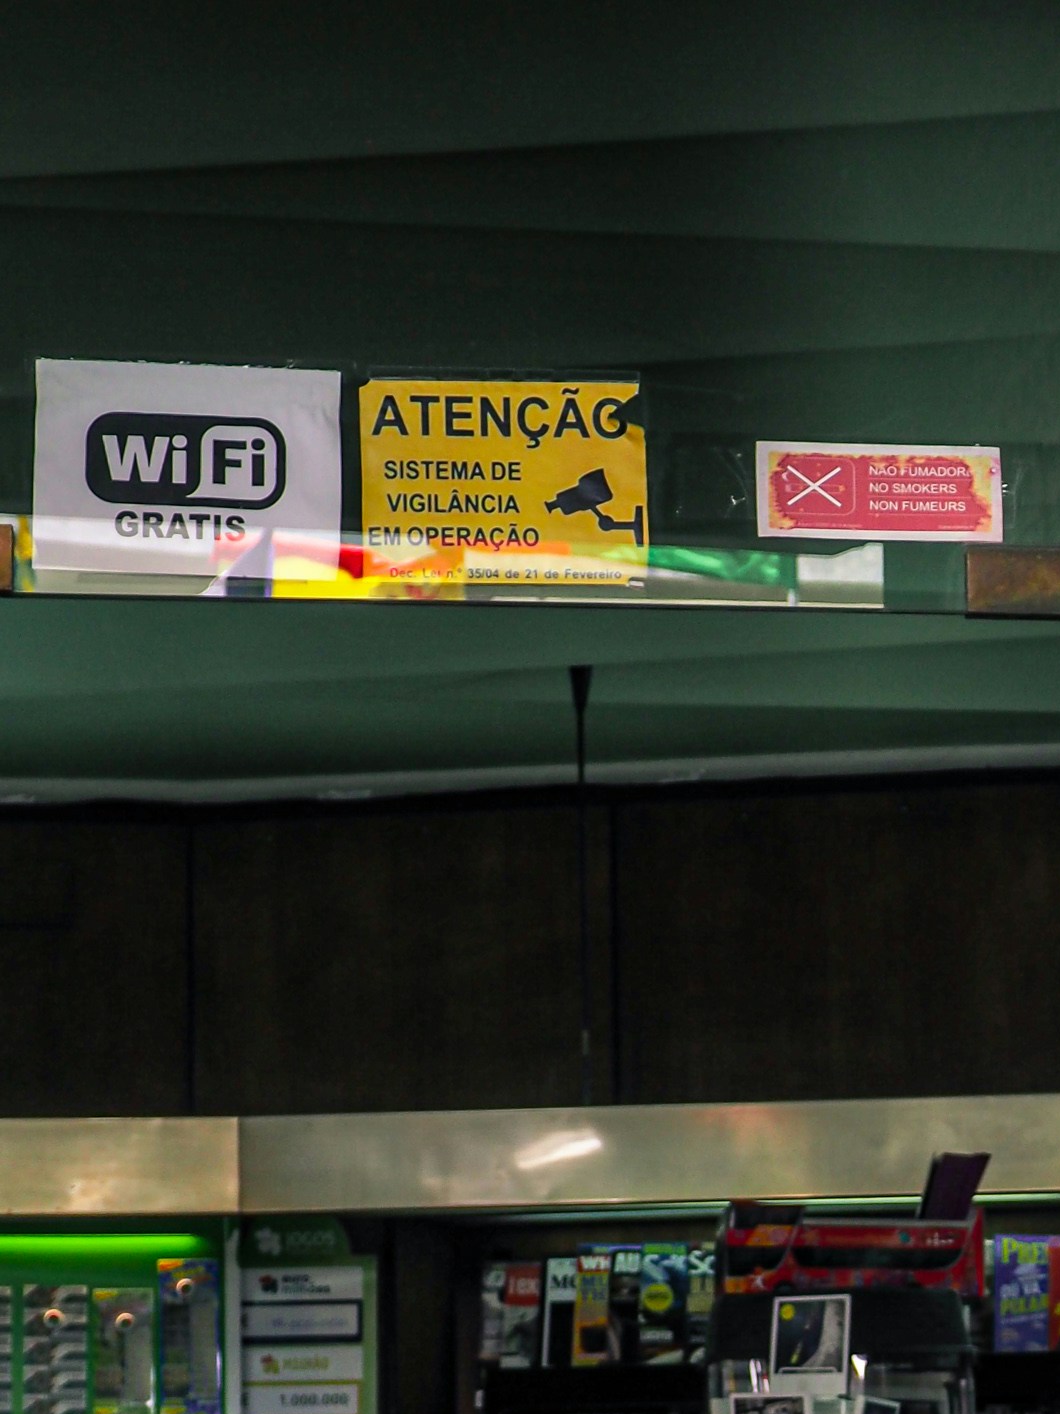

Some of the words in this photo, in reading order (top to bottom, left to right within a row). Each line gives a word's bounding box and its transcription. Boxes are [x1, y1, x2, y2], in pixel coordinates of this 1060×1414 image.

[371, 389, 628, 449] ATENÇÃO
[384, 460, 485, 481] SISTEMA
[491, 461, 522, 482] DE
[869, 482, 888, 494] NO
[893, 482, 957, 494] SMOKERS
[387, 489, 519, 514] VIGILÂNCIA
[869, 500, 898, 511] NON
[902, 500, 966, 512] FUMEURS
[114, 510, 246, 541] GRATIS
[368, 527, 401, 546] EM
[407, 523, 539, 552] OPERAÇÃO
[525, 567, 538, 580] 21
[564, 567, 621, 581] Fevereiro
